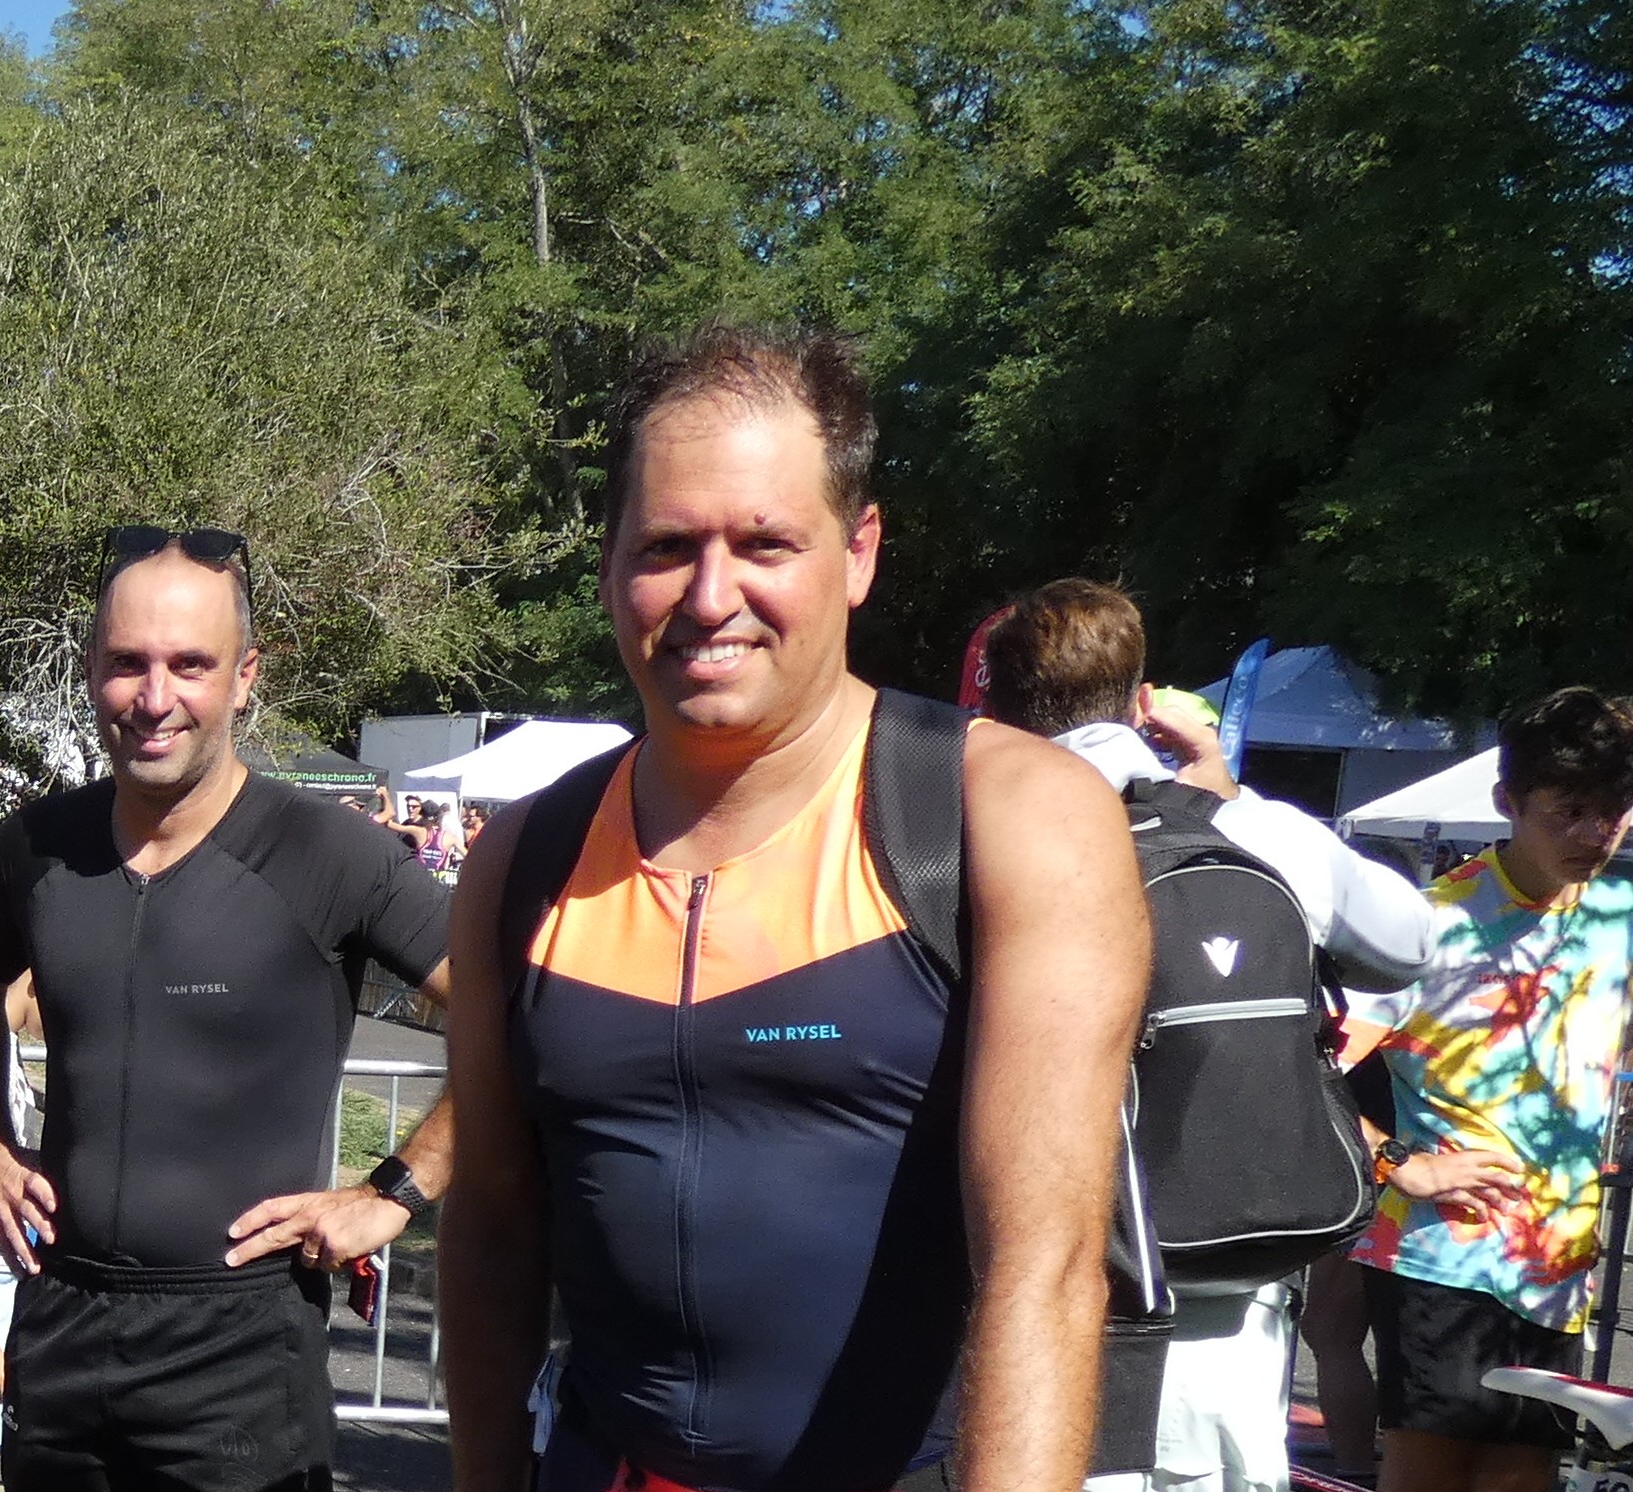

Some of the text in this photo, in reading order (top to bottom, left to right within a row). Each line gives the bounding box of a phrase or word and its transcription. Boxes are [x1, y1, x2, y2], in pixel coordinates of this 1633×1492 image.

[166, 984, 229, 995] VAN RYSEL
[746, 1024, 842, 1042] VAN RYSEL
